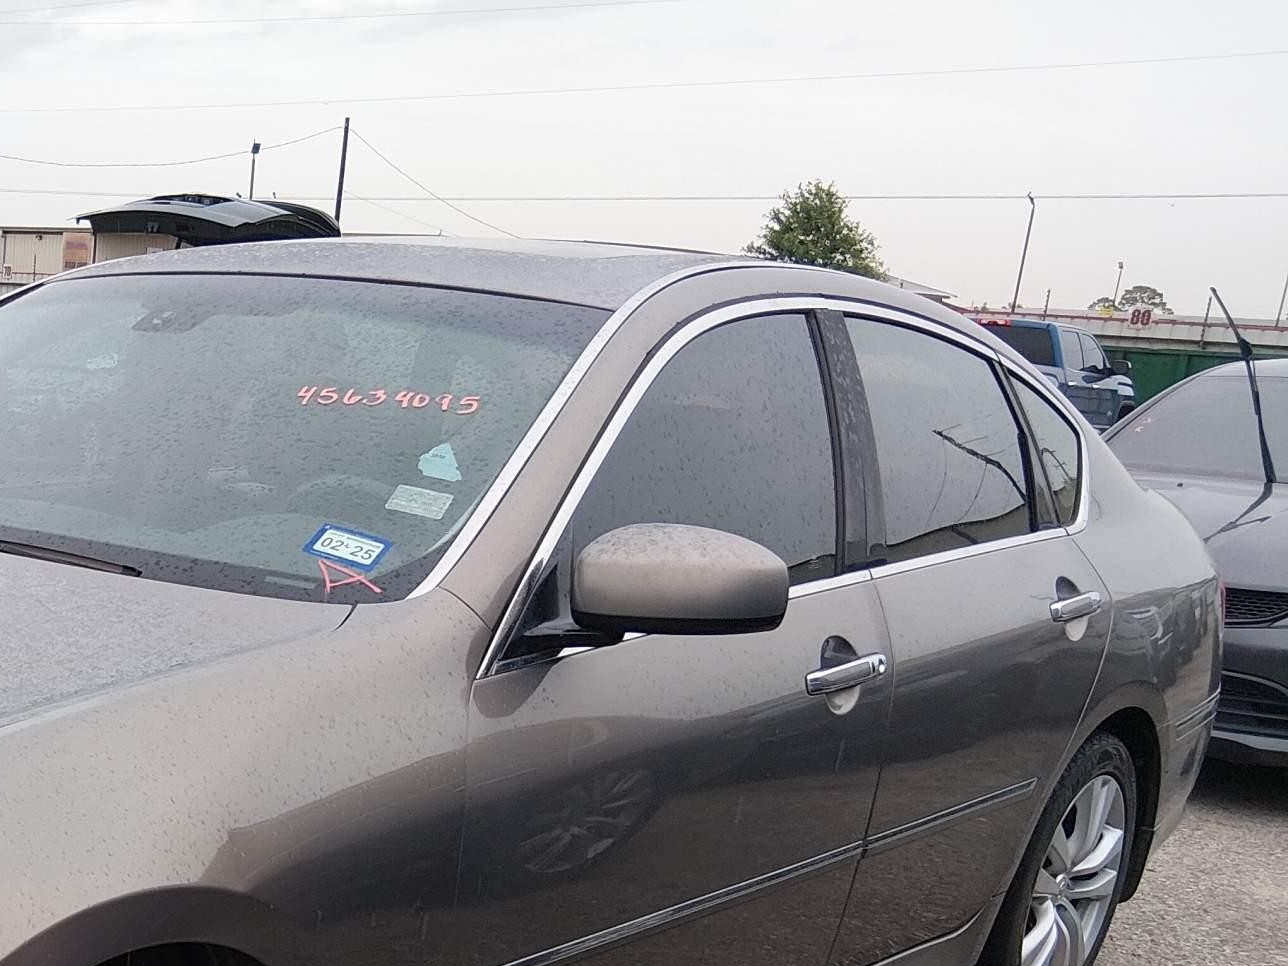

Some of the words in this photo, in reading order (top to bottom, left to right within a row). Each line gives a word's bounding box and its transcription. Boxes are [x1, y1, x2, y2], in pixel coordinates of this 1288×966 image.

[1129, 308, 1152, 326] 80
[297, 385, 481, 414] 45634095
[320, 537, 345, 552] 02
[349, 545, 376, 561] 25
